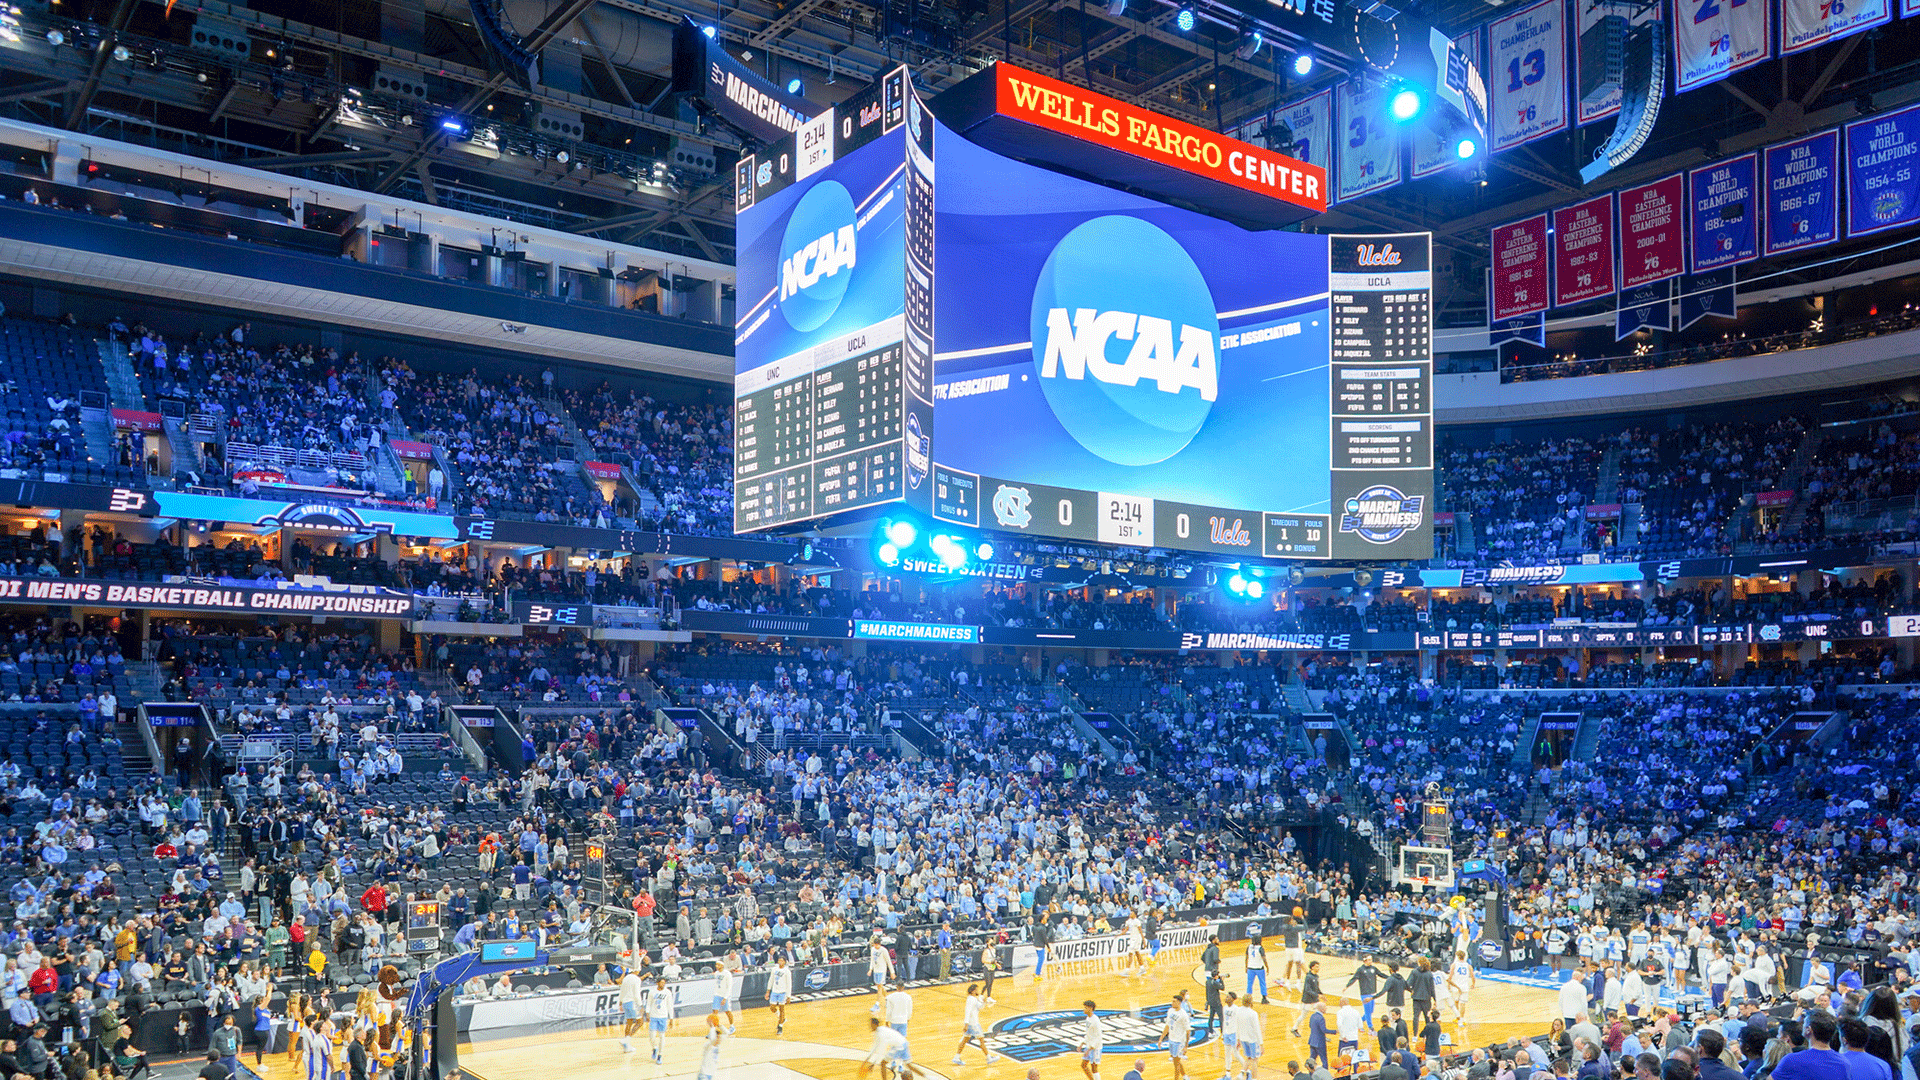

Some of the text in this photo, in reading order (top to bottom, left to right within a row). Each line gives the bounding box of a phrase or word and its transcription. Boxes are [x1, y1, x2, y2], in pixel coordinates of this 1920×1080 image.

[1516, 17, 1532, 32] WILT
[1792, 10, 1876, 44] Philadelphia 76ers
[1500, 20, 1552, 50] CHAMBERLAIN
[1710, 34, 1730, 57] 76
[1508, 48, 1546, 93] 13
[1686, 48, 1758, 80] Philadelphia 76ers
[726, 72, 812, 132] MARCHMA
[842, 102, 881, 138] 0 Ucla
[1293, 106, 1310, 120] ALLEN
[1518, 105, 1536, 124] 76
[1294, 114, 1314, 129] ERSON
[1876, 121, 1898, 137] NBA
[804, 122, 826, 150] 2:14
[1008, 78, 1318, 200] WELLS FARGO CENTER
[1498, 125, 1540, 144] Philadelphia
[1870, 132, 1904, 152] WORLD
[809, 149, 820, 165] 1ST
[1791, 146, 1810, 160] NBA
[1857, 142, 1918, 168] CHAMPIONS
[780, 154, 788, 174] 0
[1360, 160, 1374, 178] 76
[1785, 157, 1817, 174] WORLD
[1712, 168, 1730, 184] NBA
[1774, 167, 1828, 190] CHAMPIONS
[1865, 168, 1911, 190] 1954-55
[1644, 189, 1658, 200] NBA
[1708, 178, 1738, 196] WORLD
[1636, 196, 1666, 212] EASTERN
[1698, 187, 1748, 211] CHAMPIONS
[1780, 192, 1820, 212] 1966-67
[1576, 209, 1589, 220] NBA
[1630, 204, 1672, 223] CONFERENCE
[1569, 216, 1597, 232] EASTERN
[1632, 215, 1670, 232] CHAMPIONS
[1792, 220, 1808, 235] 76
[1506, 234, 1532, 248] EASTERN
[1512, 228, 1526, 238] NBA
[1564, 224, 1603, 242] CONFERENCE
[1637, 232, 1666, 248] 2000-01
[1501, 242, 1538, 259] CONFERENCE
[1566, 234, 1602, 251] CHAMPIONS
[1717, 238, 1732, 251] 76
[1772, 237, 1810, 250] Philadelphia
[1357, 244, 1402, 265] Ucla
[1503, 252, 1537, 268] CHAMPIONS
[1570, 252, 1598, 266] 1982-83
[1698, 254, 1734, 266] Philadelphia
[780, 224, 856, 302] NCAA
[1644, 256, 1660, 270] 76
[1368, 278, 1391, 286] UCLA
[1509, 269, 1532, 282] 1981-82
[1578, 274, 1591, 288] 76
[1628, 271, 1662, 284] Philadelphia
[1697, 278, 1716, 287] NCAA
[1514, 290, 1528, 304] 76
[1562, 288, 1594, 300] Philadelphia
[1634, 291, 1654, 300] NCAA
[1500, 304, 1530, 314] Philadelphia
[1240, 322, 1301, 347] ASSOCIATION
[848, 335, 866, 352] UCLA
[1042, 308, 1218, 402] NCAA
[766, 366, 780, 381] UNC
[948, 374, 1010, 398] ASSOCIATION
[874, 452, 894, 464] STL 0
[874, 467, 894, 479] BLK 0
[876, 482, 894, 493] TO 0
[952, 476, 973, 489] TIMEOUTS
[938, 484, 964, 504] 10 1
[301, 505, 340, 516] SWEET 16
[941, 504, 956, 515] BONUS
[1059, 500, 1072, 526] 0
[1111, 501, 1142, 523] 2:14
[1359, 501, 1400, 512] MARCH
[1177, 514, 1190, 538] 0
[1271, 518, 1323, 528] TIMEOUTS FOULS
[1363, 513, 1420, 525] MADNESS
[1118, 525, 1134, 538] 1ST
[1210, 516, 1251, 546] Ucla
[1281, 528, 1320, 542] 1 10
[1294, 544, 1316, 553] BONUS
[960, 562, 1028, 580] SIXTEEN
[27, 582, 102, 600] MEN'S
[107, 586, 245, 607] BASKETBALL
[251, 593, 410, 614] CHAMPIONSHIP
[860, 623, 972, 640] #MARCHMADNESS
[1806, 620, 1872, 636] UNC 0
[1207, 634, 1324, 649] MARCHMADNESS
[1423, 636, 1440, 645] 9:51
[1573, 634, 1580, 642] 0
[1596, 634, 1616, 642] 3PT%
[1626, 632, 1634, 641] 0
[1675, 631, 1682, 640] 0
[1720, 632, 1742, 641] 10 1
[180, 716, 195, 726] 114
[480, 718, 492, 726] 113
[684, 718, 696, 726] 112
[1046, 929, 1208, 962] UNIVERSITY OF SYLVANIA
[1457, 966, 1467, 976] 43
